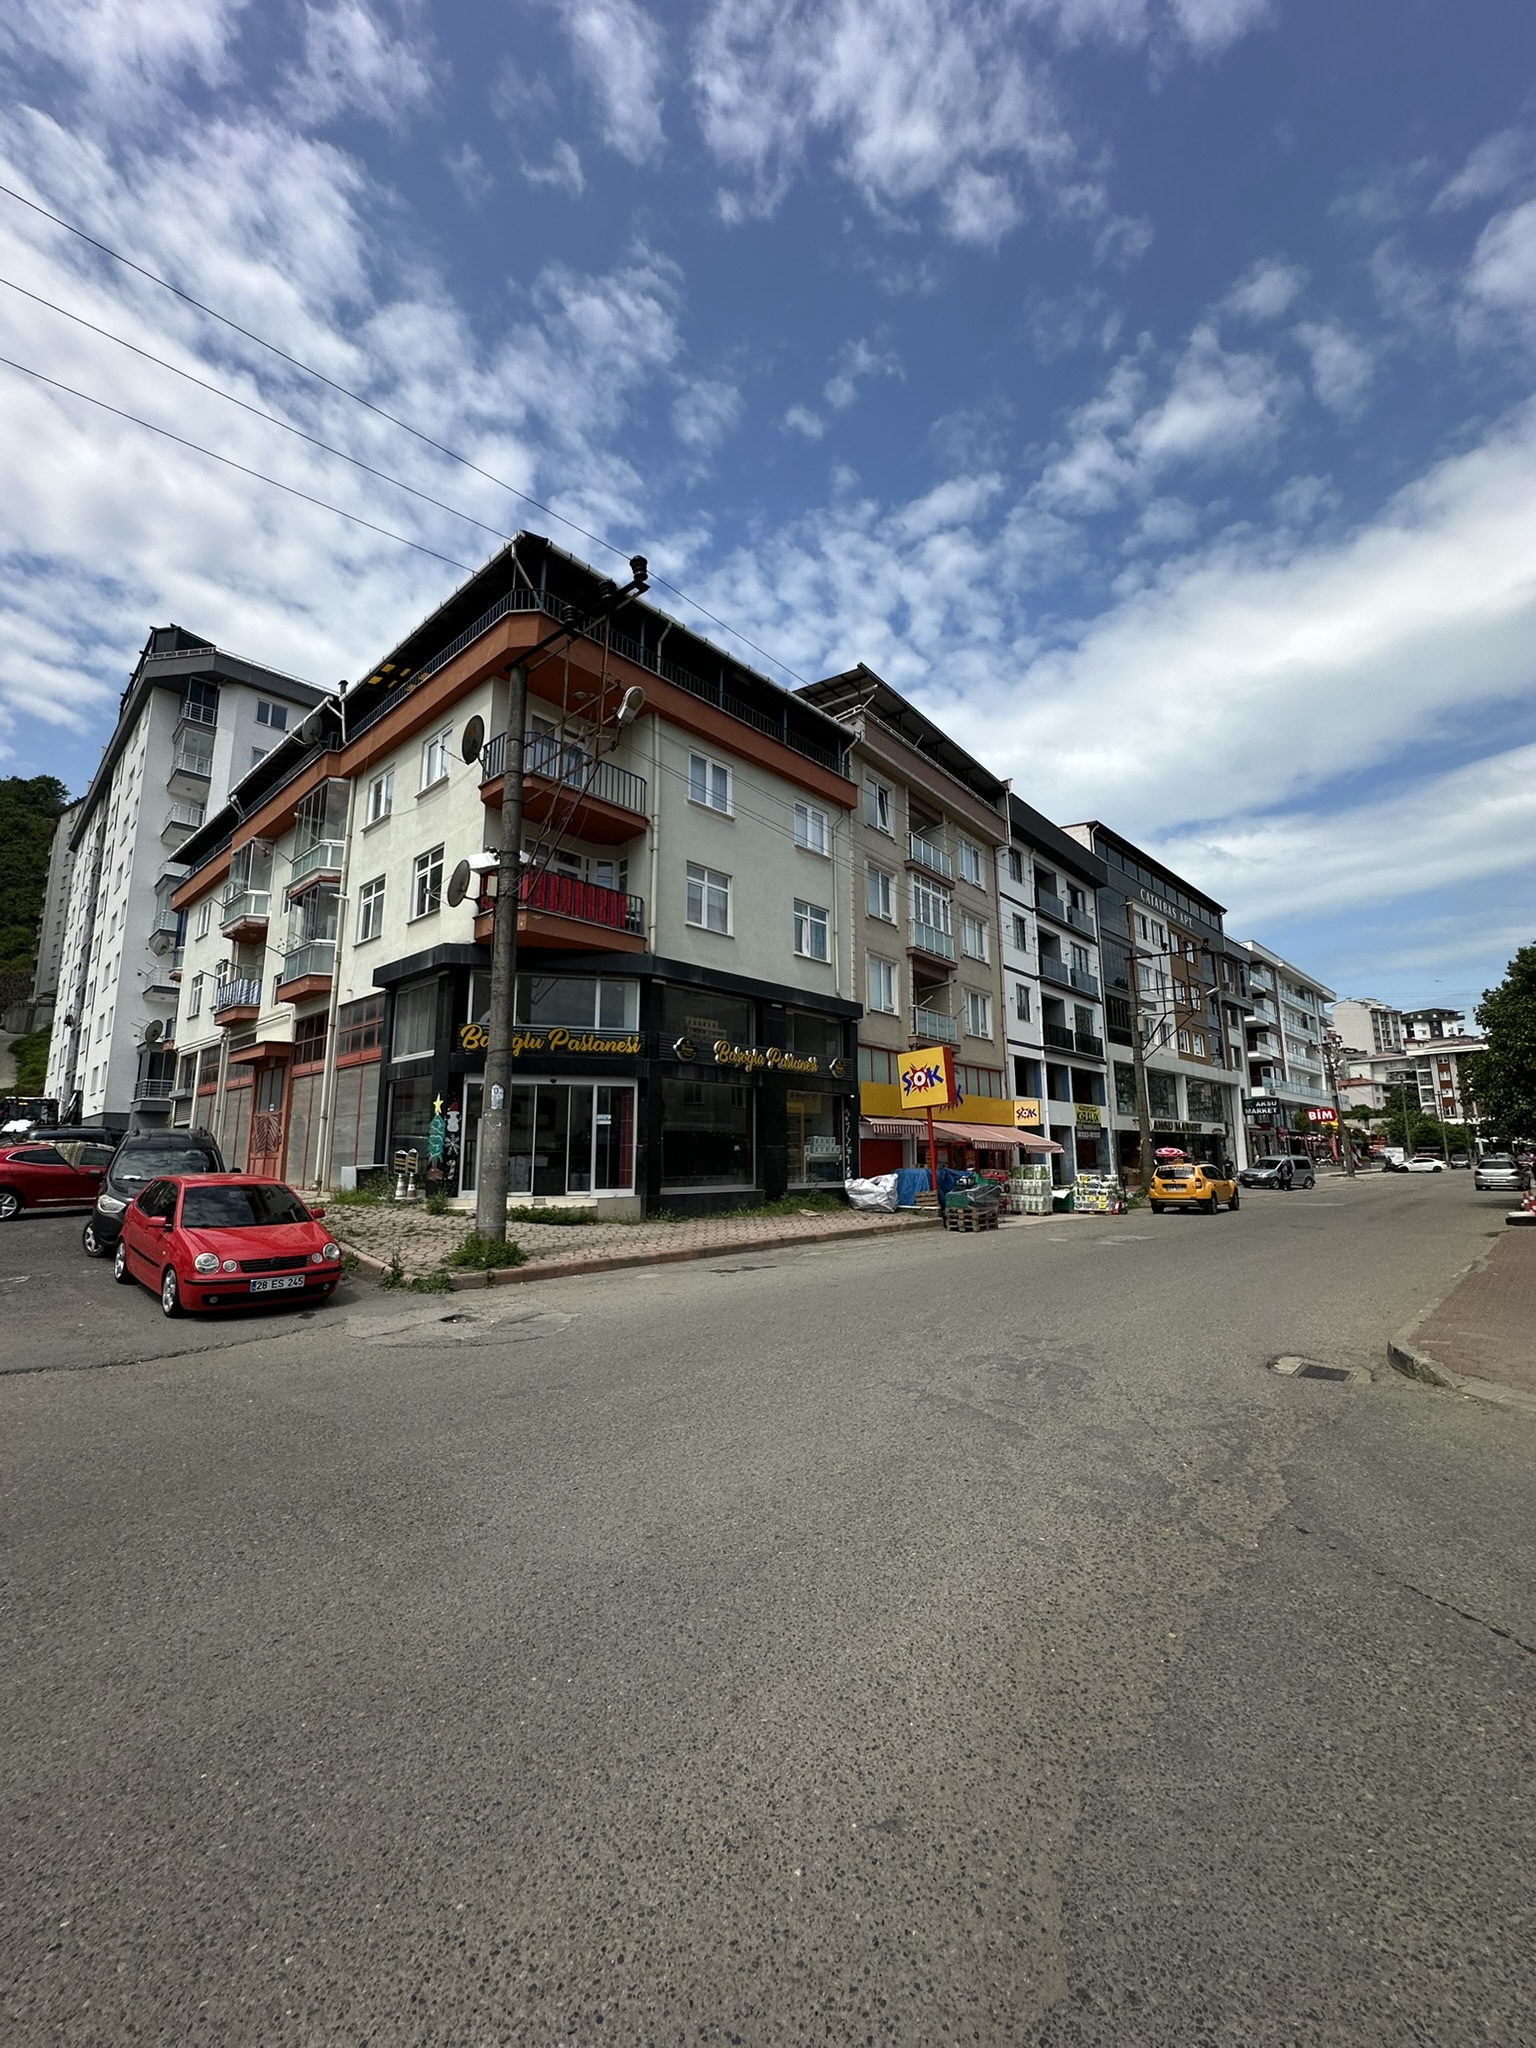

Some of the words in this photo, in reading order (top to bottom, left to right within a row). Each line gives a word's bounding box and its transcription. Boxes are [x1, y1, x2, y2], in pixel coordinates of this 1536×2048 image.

[460, 1024, 545, 1057] Bağlu
[1244, 1107, 1278, 1115] MARKET
[1308, 1109, 1333, 1120] BİM
[256, 1281, 268, 1290] 28
[271, 1279, 284, 1288] ES
[287, 1278, 303, 1287] 245
